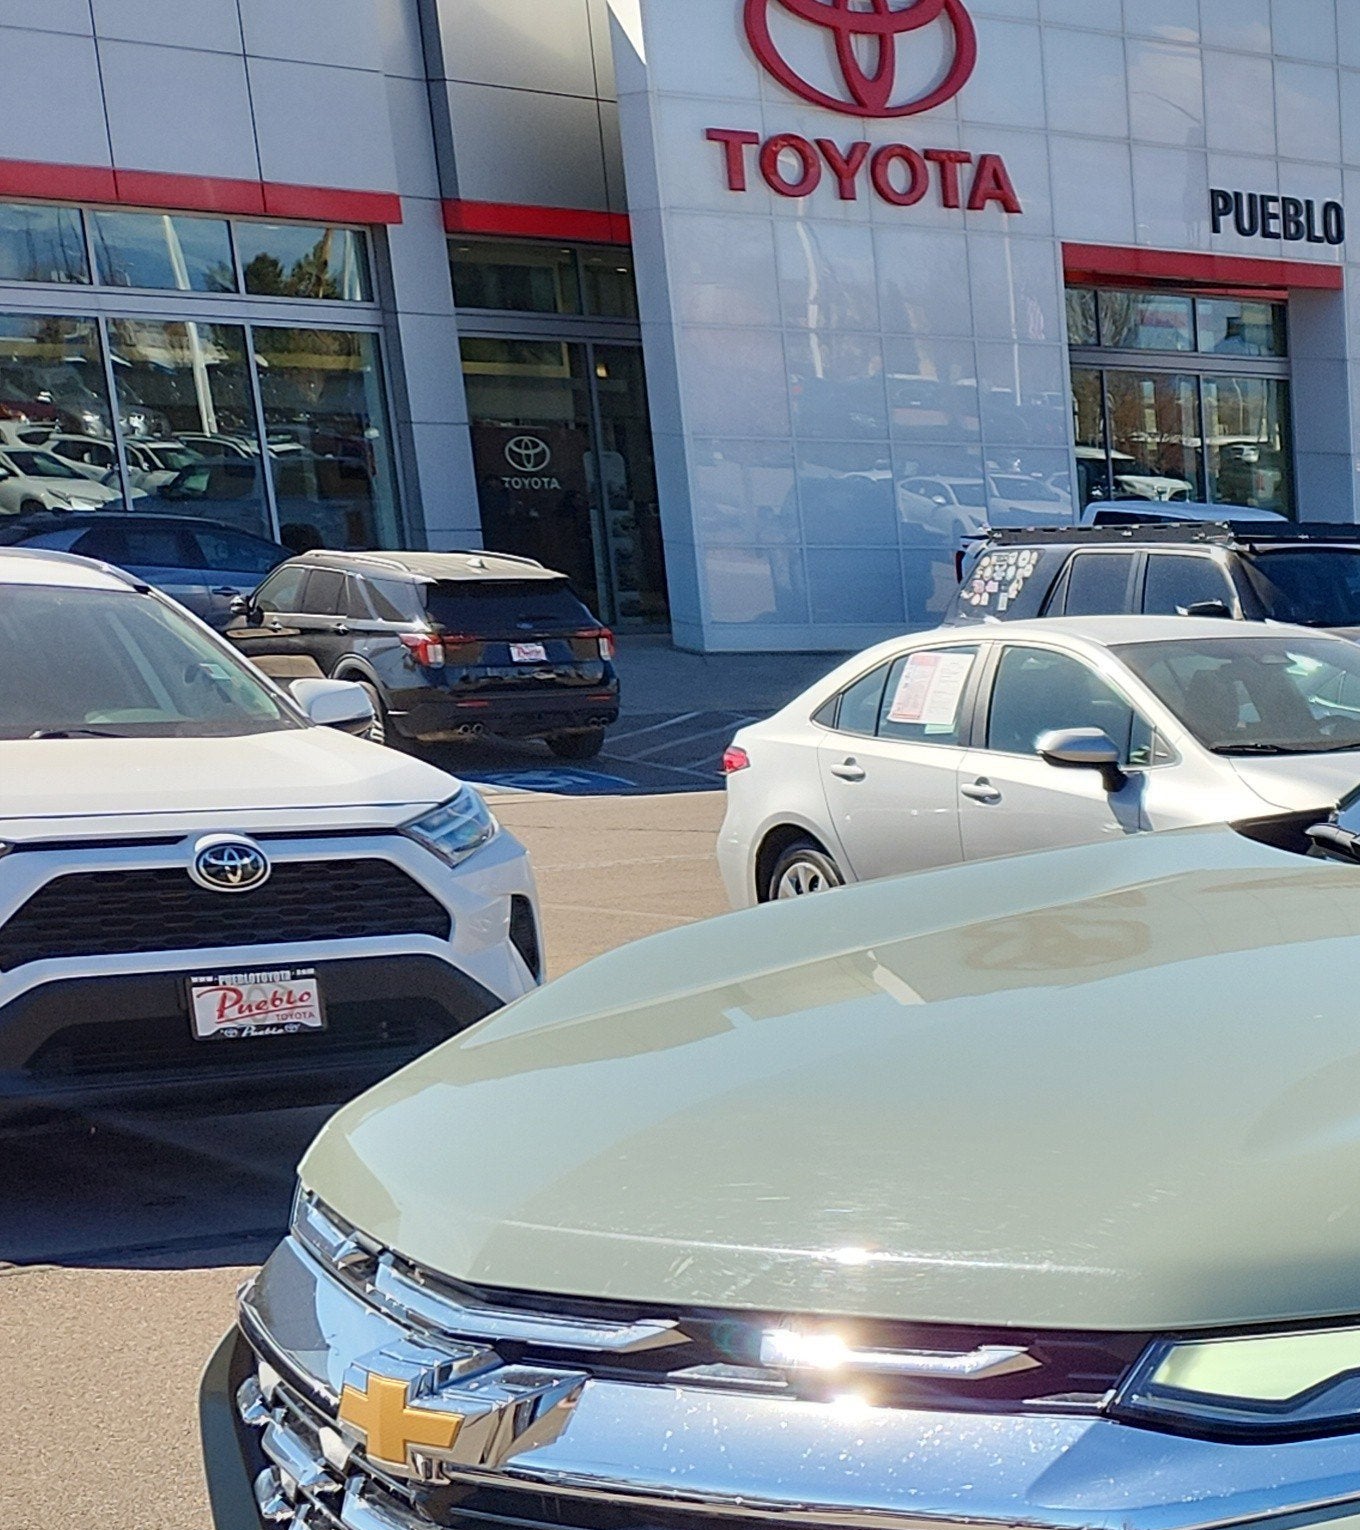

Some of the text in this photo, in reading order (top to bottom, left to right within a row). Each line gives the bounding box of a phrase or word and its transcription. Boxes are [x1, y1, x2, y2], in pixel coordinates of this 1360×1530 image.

[706, 127, 1023, 214] TOYOTA
[1210, 188, 1345, 245] PUEBLO
[501, 477, 562, 490] TOYOTA
[197, 987, 311, 1020] Pueblo
[275, 1010, 315, 1021] TOYOTA
